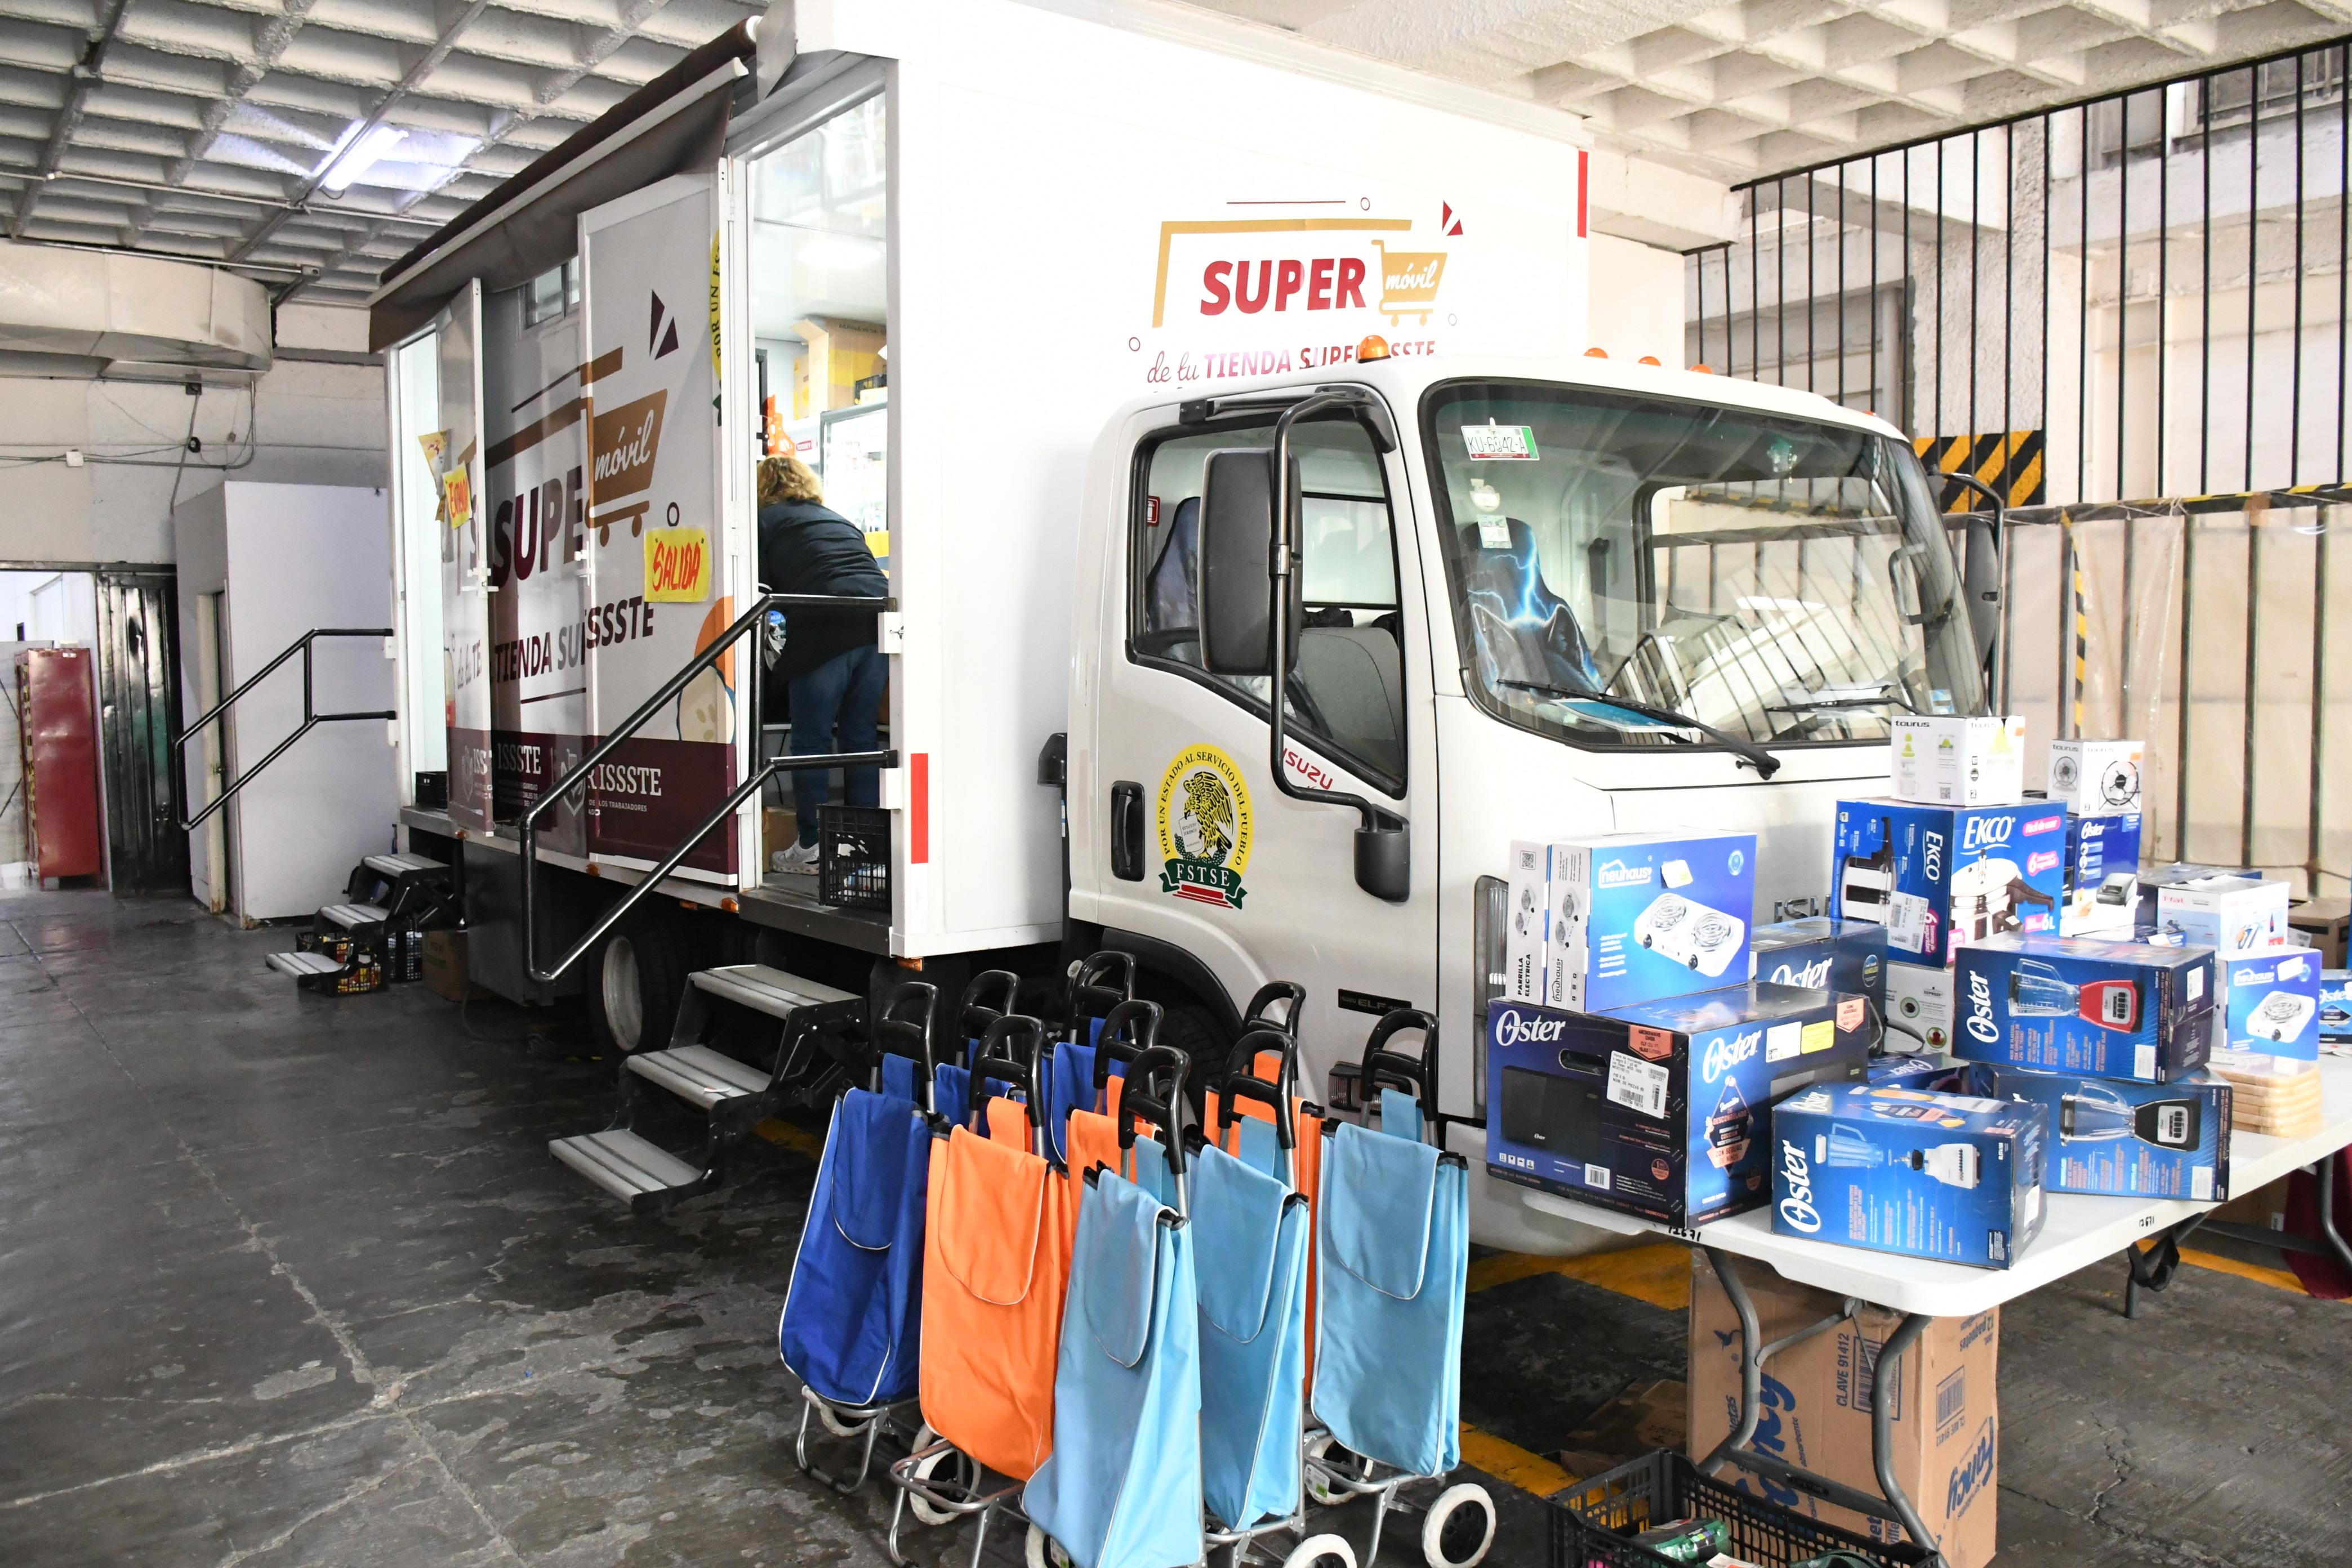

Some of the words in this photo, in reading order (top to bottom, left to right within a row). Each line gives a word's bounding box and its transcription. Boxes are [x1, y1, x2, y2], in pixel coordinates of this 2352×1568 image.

[1200, 258, 1366, 316] SUPER
[1385, 260, 1438, 290] móvil
[1147, 350, 1171, 384] de
[1177, 350, 1200, 381] tu
[1204, 349, 1291, 378] TIENDA
[595, 409, 654, 482] móvil
[652, 540, 702, 592] SALIDA
[495, 631, 553, 683] TIENDA
[1184, 754, 1196, 766] AL
[1196, 751, 1235, 782] SERVICIO
[1161, 761, 1184, 803] ESTADO
[1233, 782, 1243, 809] DEL
[609, 801, 647, 812] TRABAJADORES
[1159, 806, 1166, 824] UN
[1159, 830, 1171, 855] POR
[1235, 812, 1248, 866] PUEBLO
[1963, 816, 2012, 849] EKCO
[1926, 830, 1944, 882] EKCO
[1177, 863, 1230, 887] FSTSE
[1602, 865, 1651, 883] neuhaus
[1770, 957, 1833, 986] Oster
[1358, 999, 1387, 1009] ELF
[1967, 970, 1999, 1043] Oster
[1495, 1010, 1566, 1046] Oster
[1703, 1030, 1762, 1083] Oster
[1780, 1139, 1821, 1233] Oster
[1838, 1333, 1850, 1367] 91412
[1837, 1369, 1849, 1407] CLAVE
[1793, 1416, 1807, 1468] absorbente
[1946, 1416, 1994, 1520] Fancy
